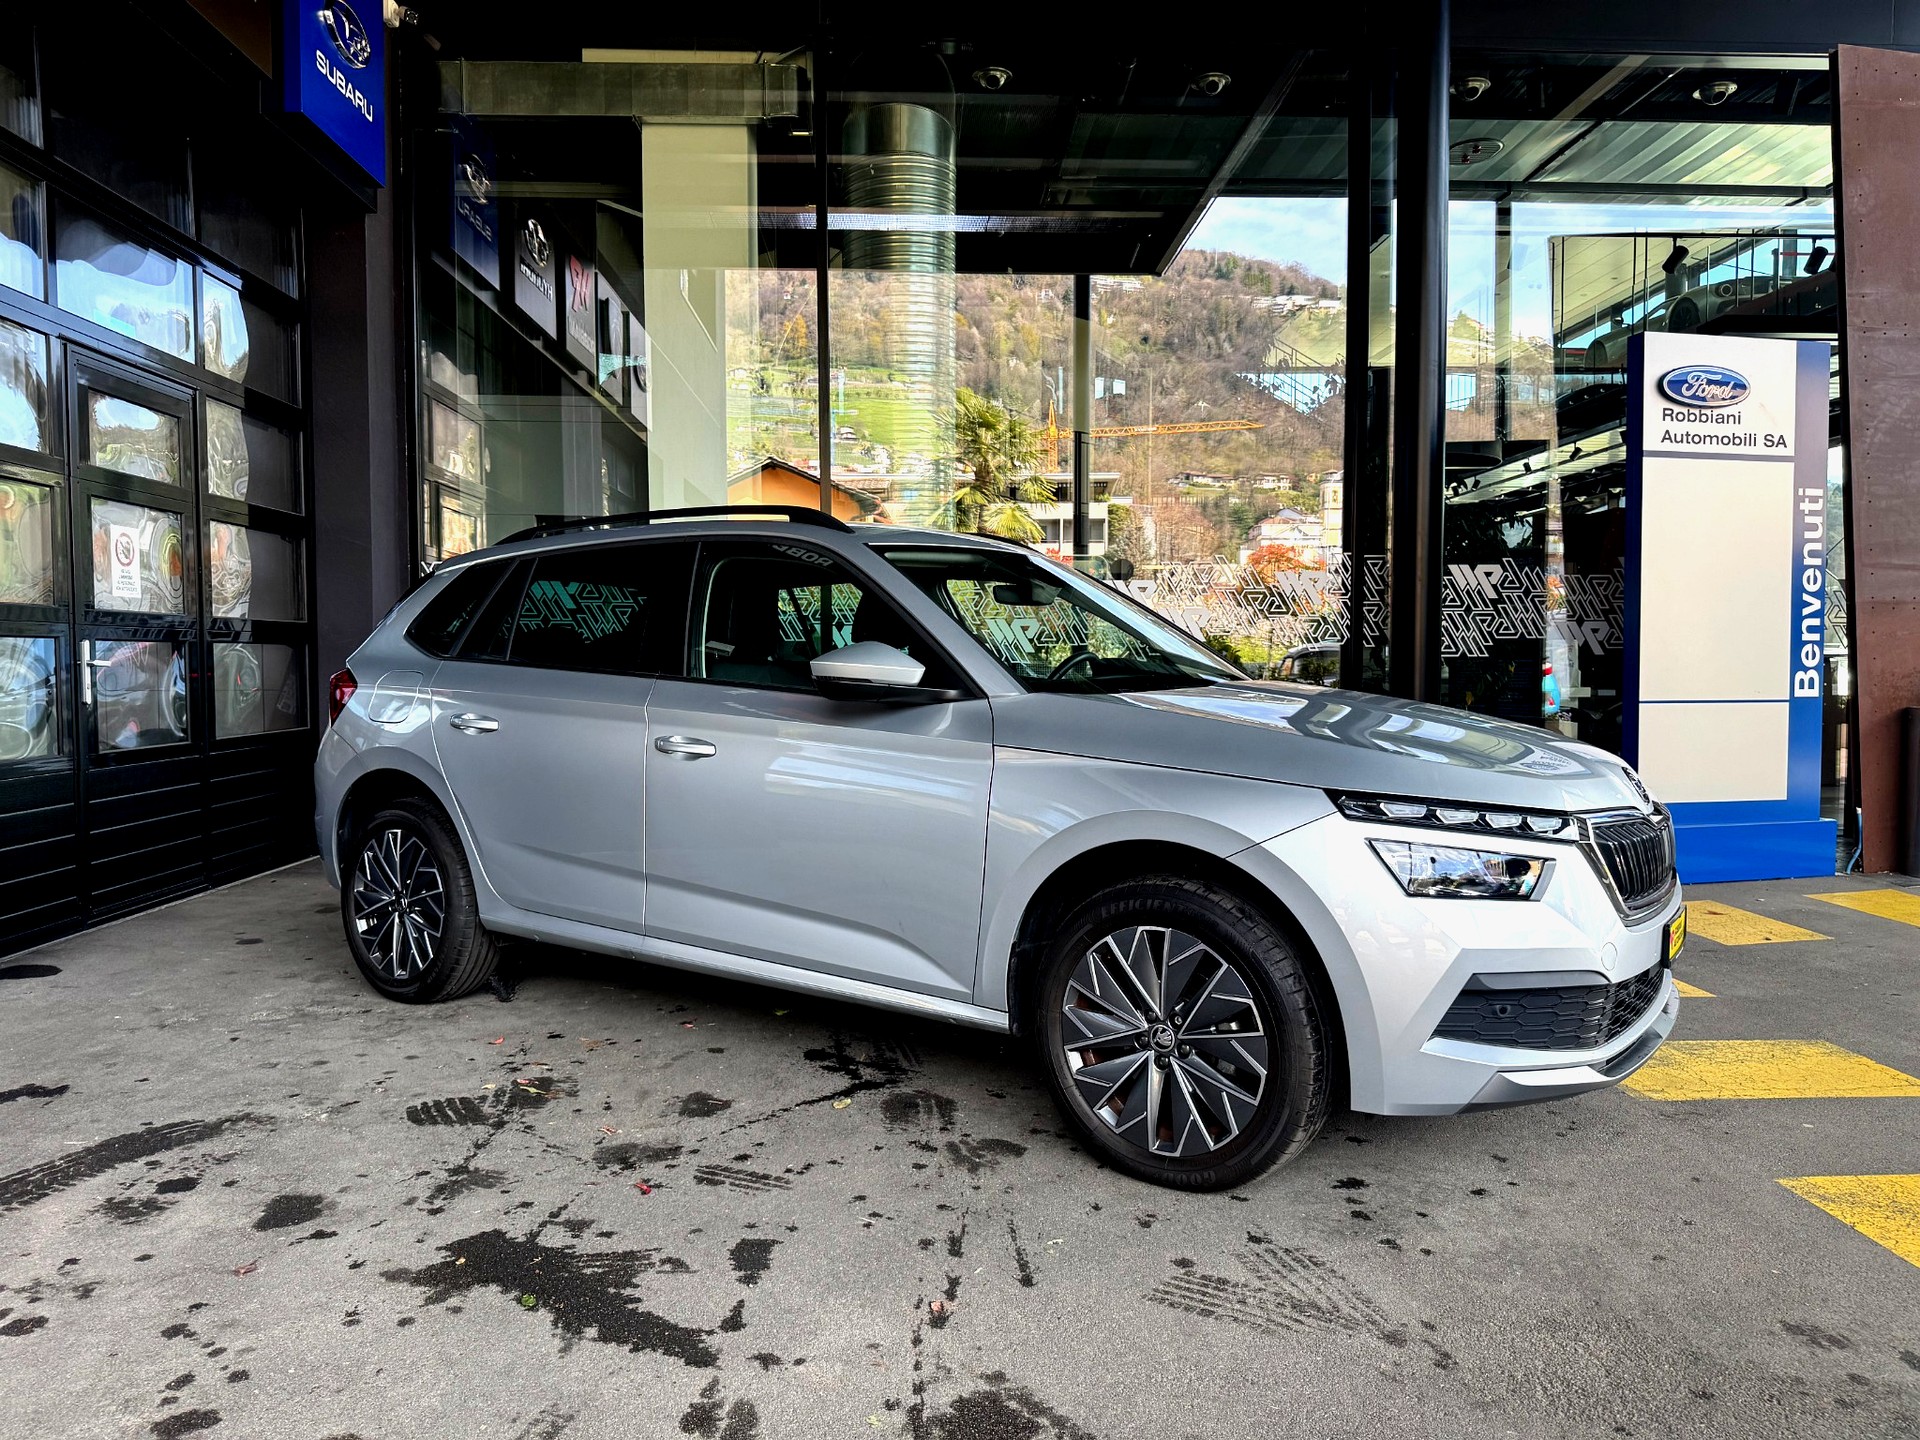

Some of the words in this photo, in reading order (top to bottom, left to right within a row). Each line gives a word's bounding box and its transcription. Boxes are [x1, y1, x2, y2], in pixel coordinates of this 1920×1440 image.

[316, 50, 373, 122] SUBARU
[1680, 371, 1734, 400] Ford
[1661, 407, 1742, 426] Robbiani
[1660, 428, 1757, 448] Automobili
[1763, 433, 1788, 449] SA
[1794, 487, 1824, 698] Benvenuti
